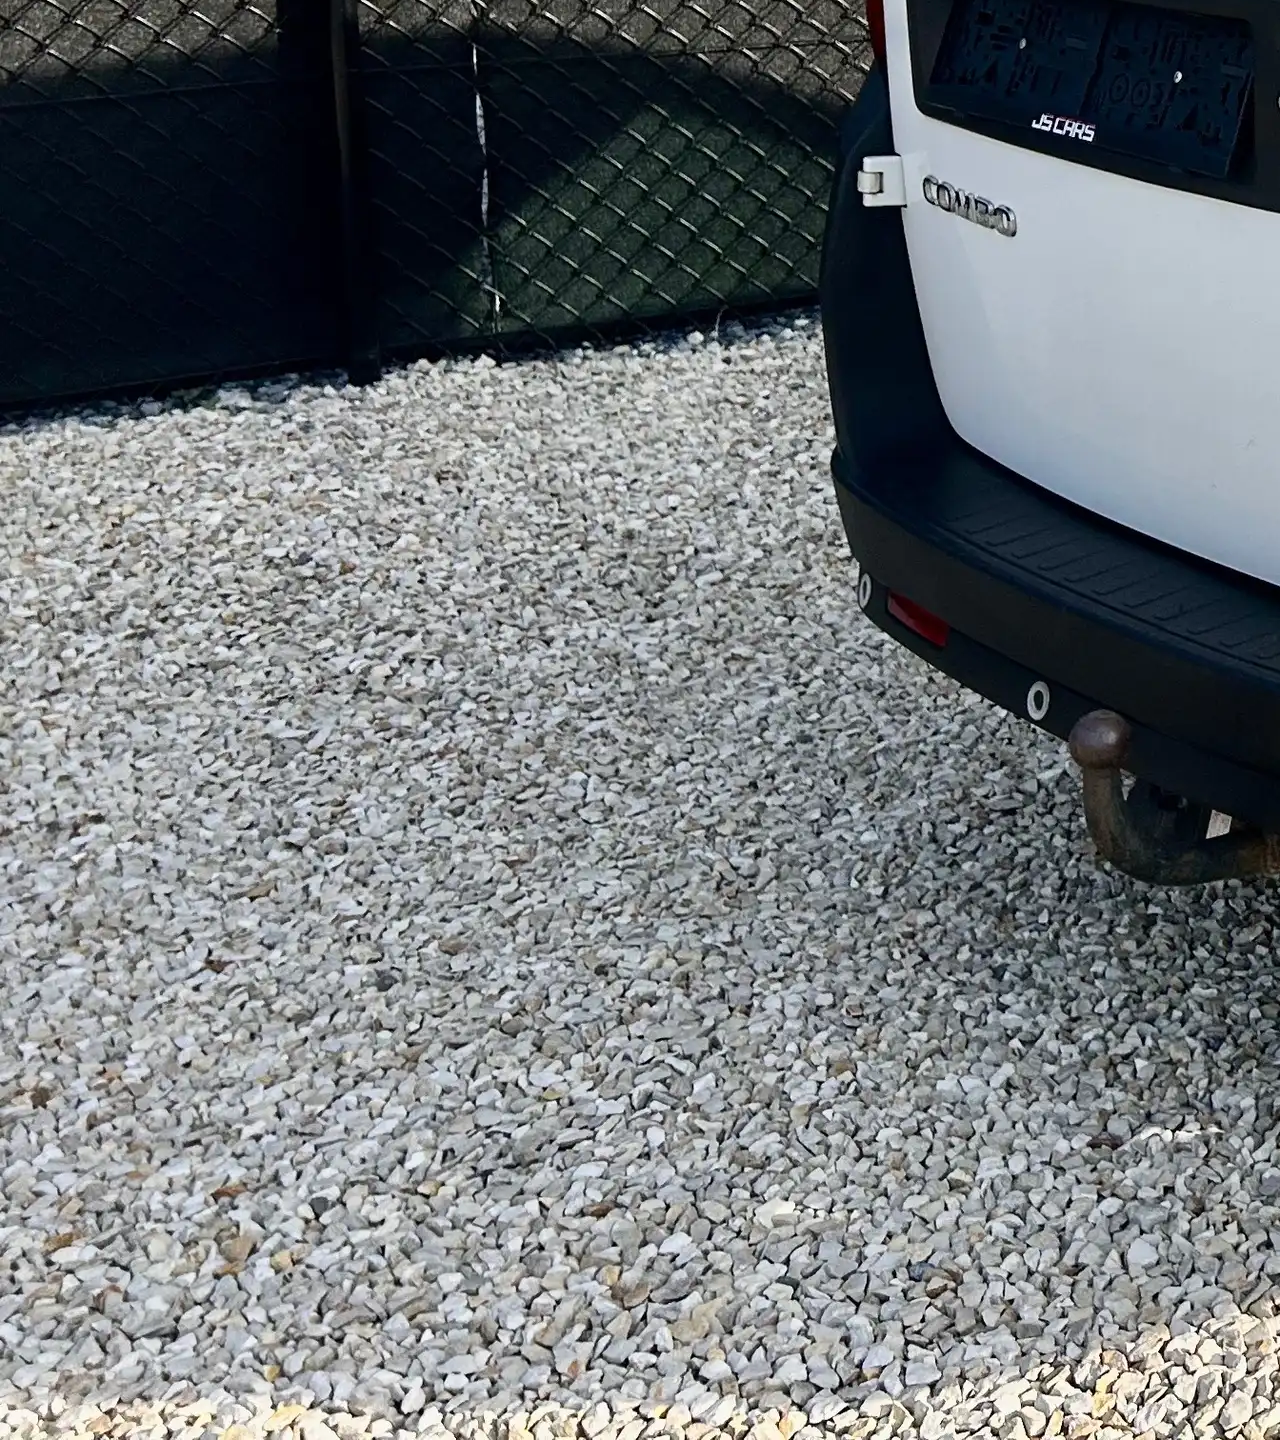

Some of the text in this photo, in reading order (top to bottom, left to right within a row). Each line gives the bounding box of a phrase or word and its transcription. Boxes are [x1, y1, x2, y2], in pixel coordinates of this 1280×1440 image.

[1031, 112, 1096, 142] JS CARS
[922, 174, 1018, 238] COMBO
